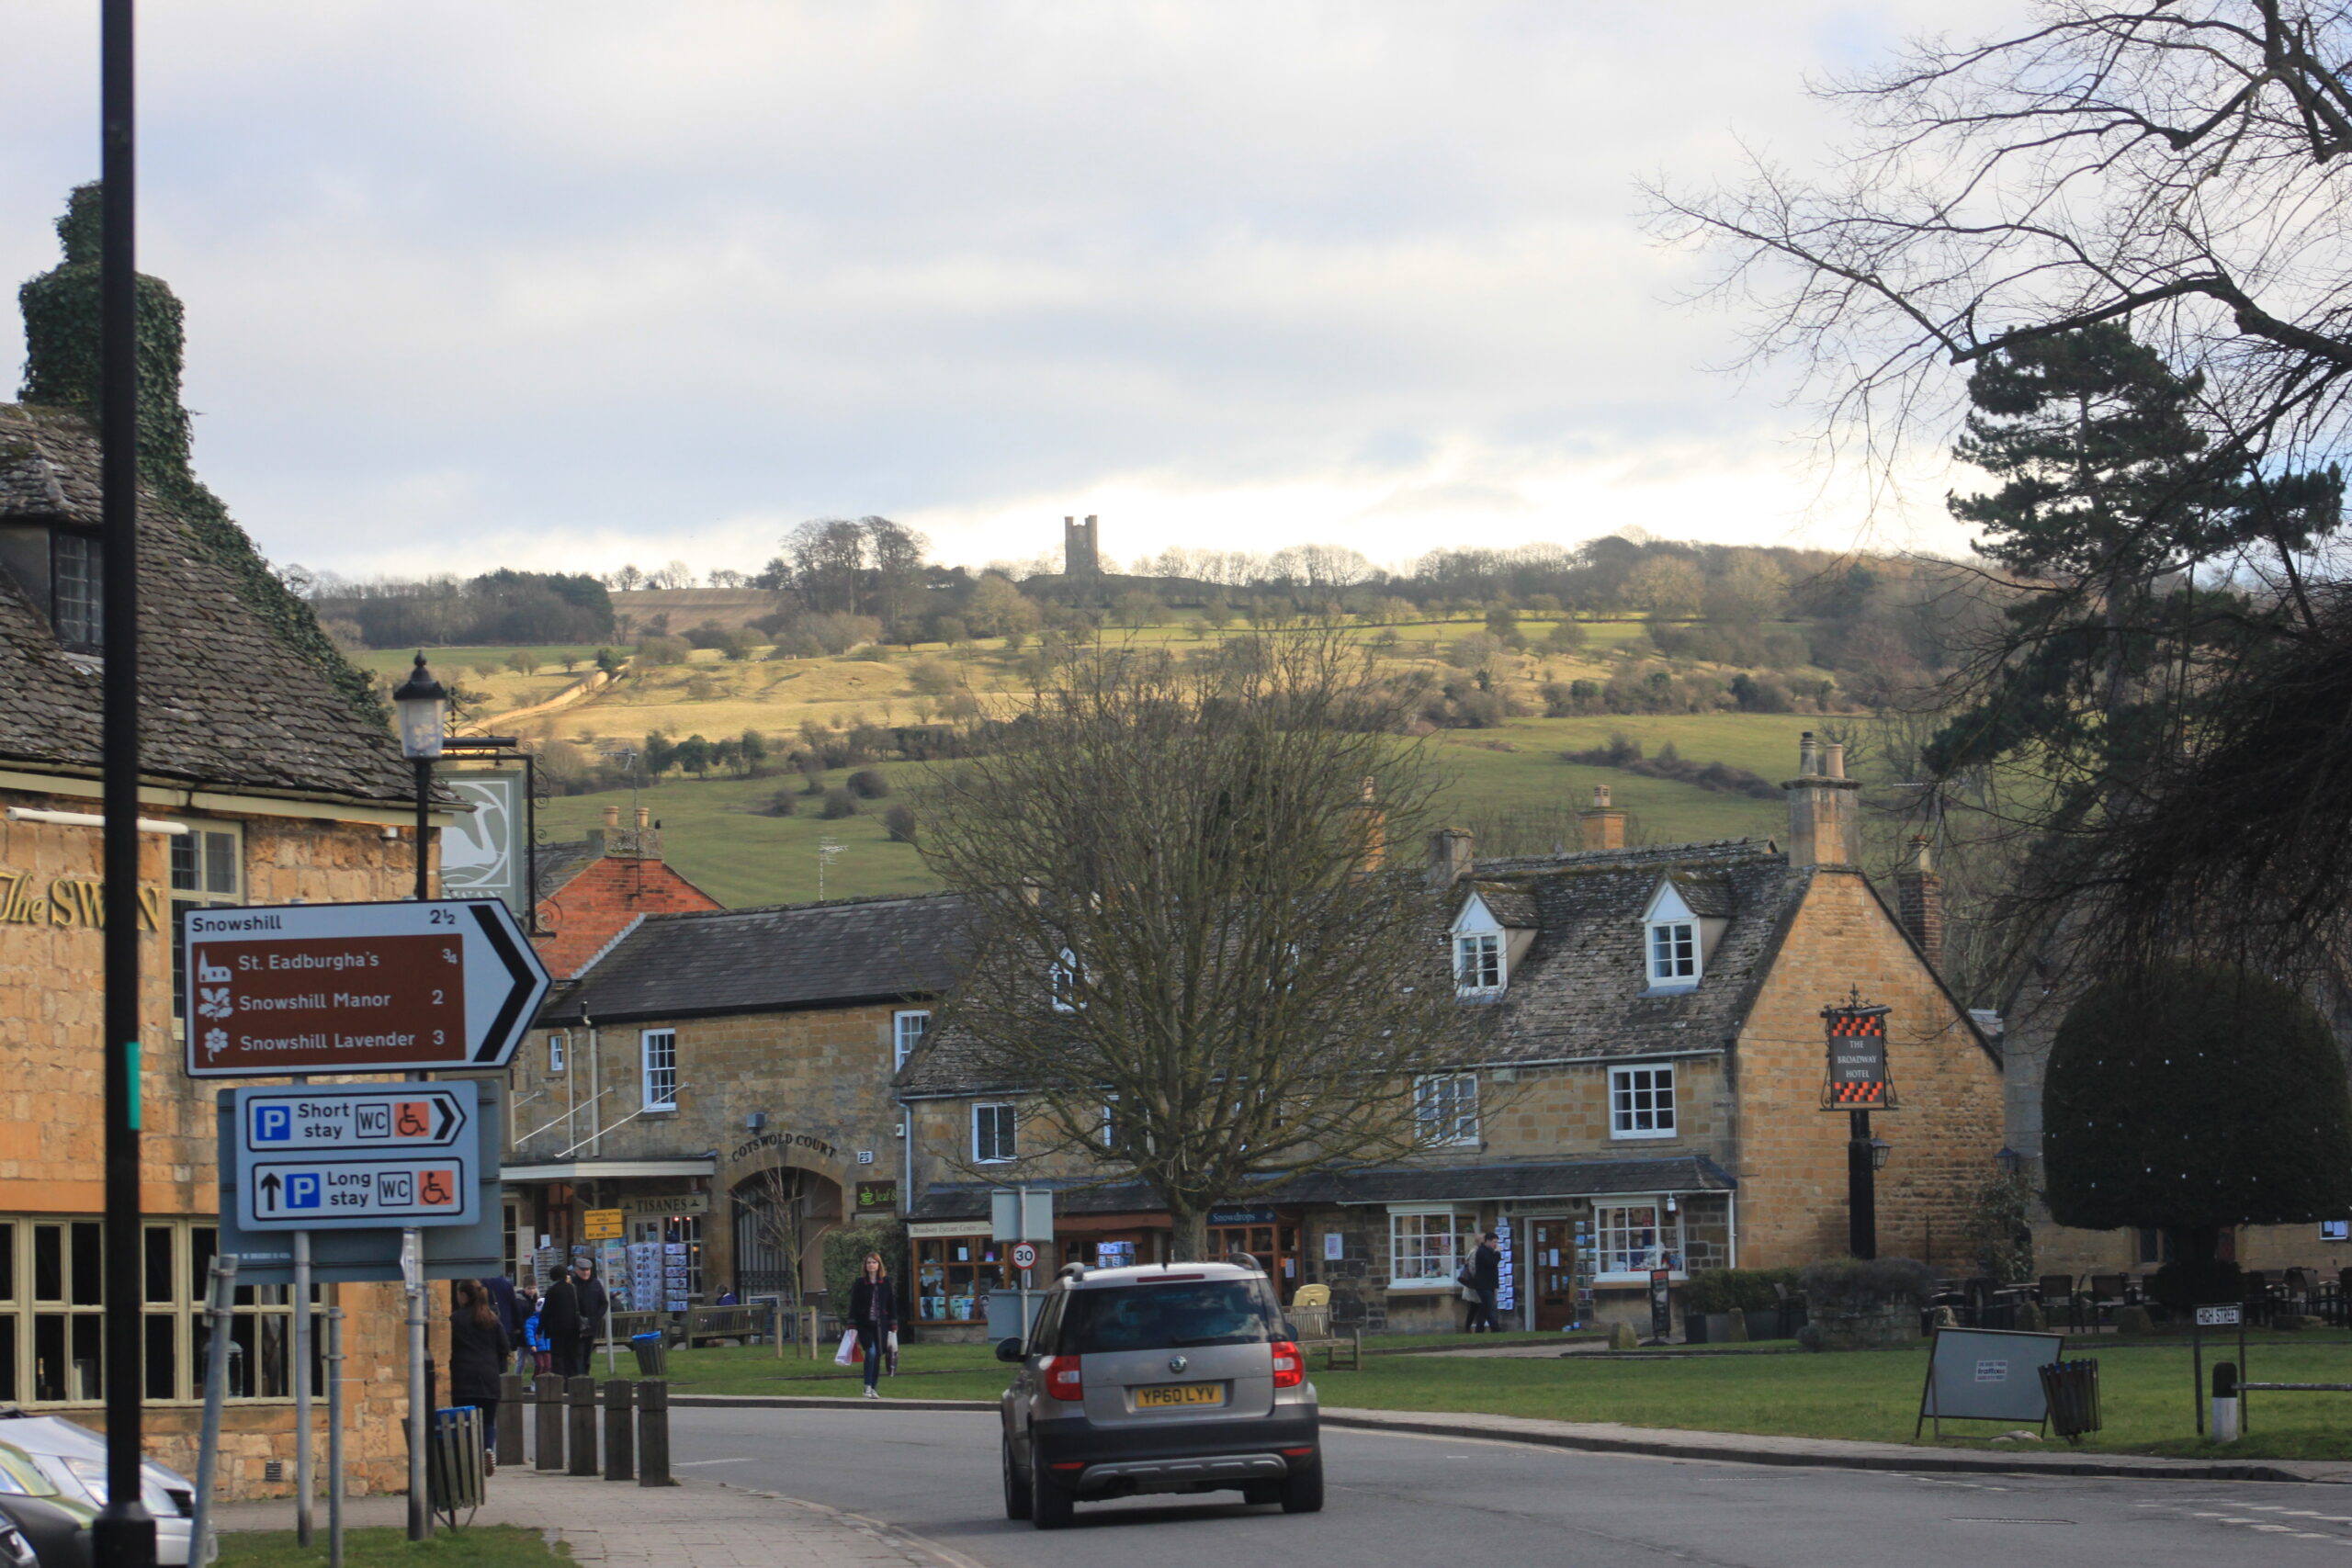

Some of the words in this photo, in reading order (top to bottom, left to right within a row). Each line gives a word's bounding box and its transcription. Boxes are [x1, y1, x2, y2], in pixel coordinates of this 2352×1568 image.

[0, 874, 46, 922] The
[50, 878, 163, 932] SWN
[192, 914, 283, 932] Snowshill
[238, 955, 265, 971] St.
[268, 952, 379, 971] Eadburgha's
[239, 994, 326, 1011] Snowshill
[334, 992, 391, 1009] Manor
[432, 989, 444, 1005] 2
[240, 1033, 328, 1051] Snowshill
[334, 1031, 416, 1049] Lavender
[433, 1030, 446, 1045] 3
[1849, 1040, 1864, 1049] THE
[1838, 1055, 1877, 1064] BROADWAY
[1846, 1069, 1871, 1078] HOTEL
[297, 1102, 350, 1119] Short
[264, 1109, 286, 1138] P
[359, 1111, 387, 1130] WC
[304, 1122, 343, 1140] stay
[731, 1133, 793, 1163] COTSWOLD
[796, 1134, 837, 1159] COURT
[326, 1171, 371, 1188] Long
[381, 1179, 409, 1198] WC
[293, 1177, 315, 1205] P
[330, 1190, 369, 1207] stay
[635, 1198, 688, 1213] TISANES
[1213, 1212, 1256, 1223] Snowdrops
[1015, 1250, 1034, 1261] 30
[2197, 1308, 2214, 1324] HIGH
[2215, 1306, 2240, 1323] STREET
[1141, 1388, 1182, 1404] YP60
[1185, 1386, 1216, 1402] LYV
